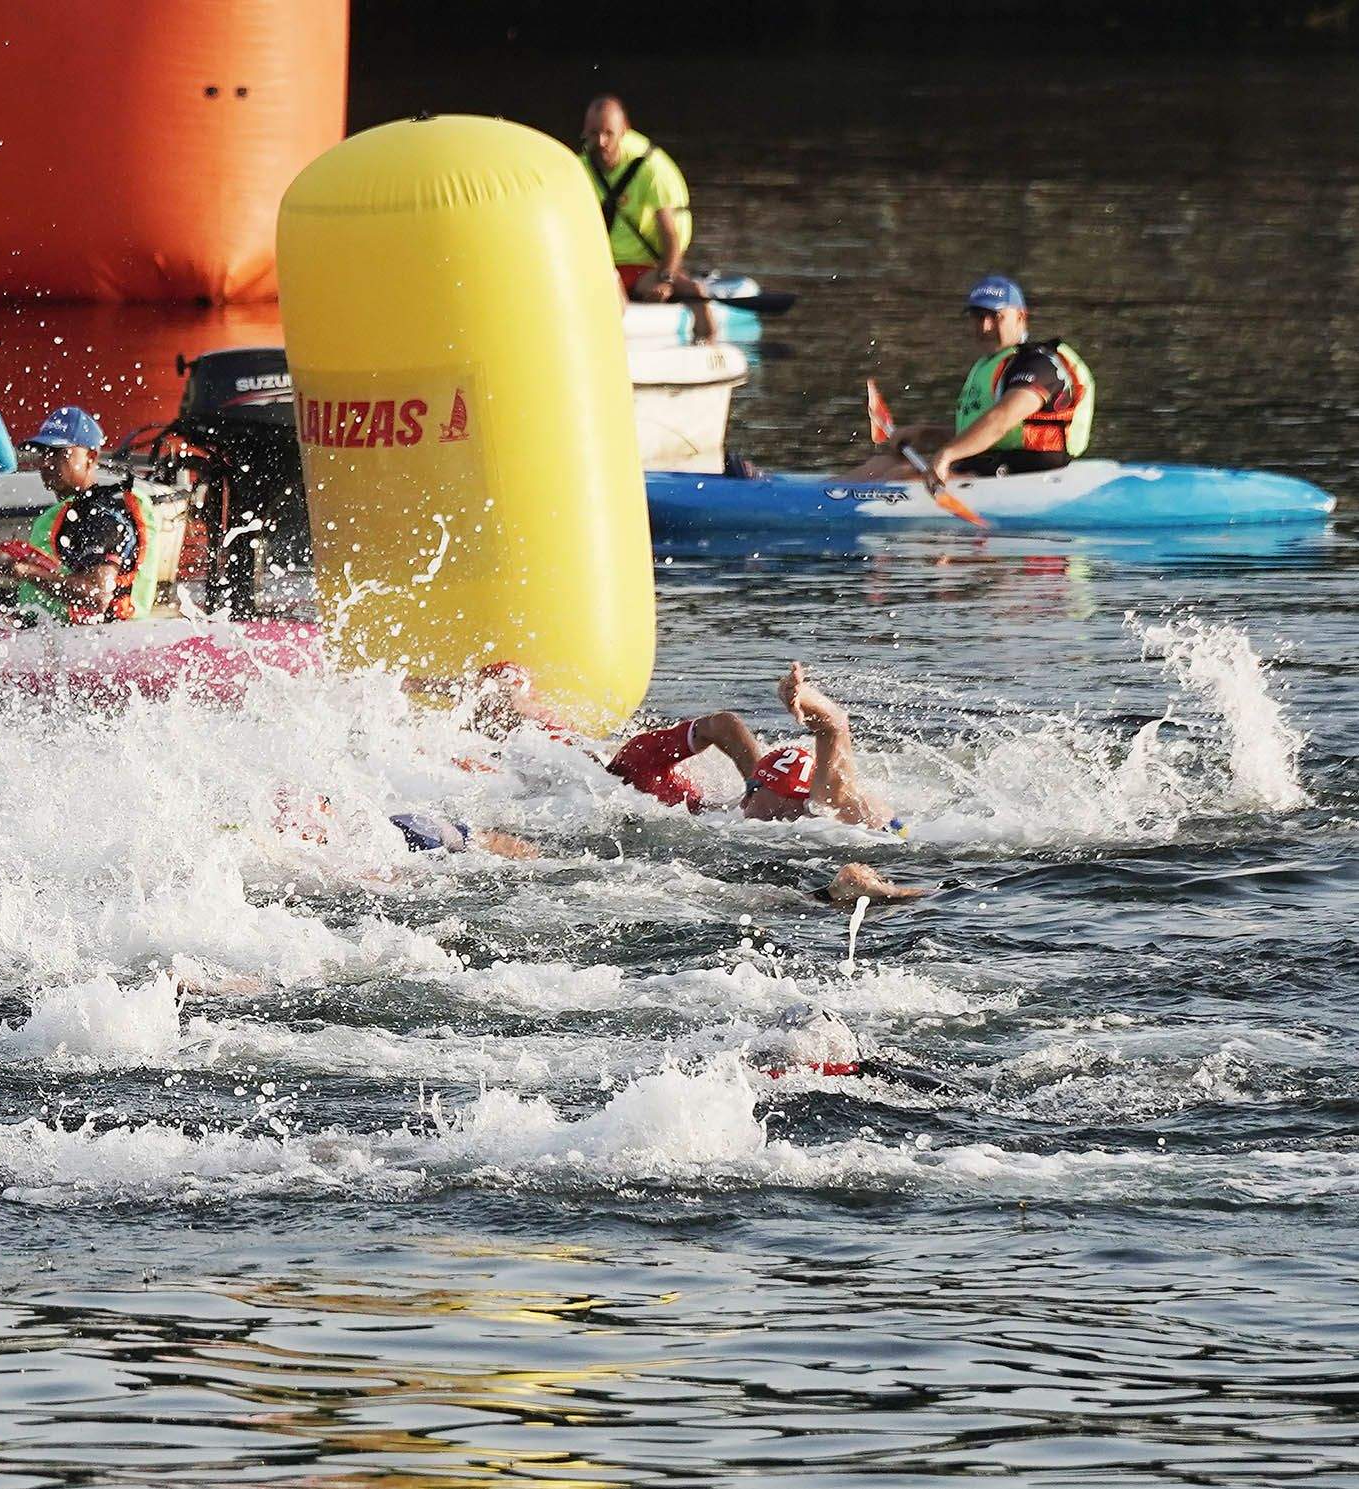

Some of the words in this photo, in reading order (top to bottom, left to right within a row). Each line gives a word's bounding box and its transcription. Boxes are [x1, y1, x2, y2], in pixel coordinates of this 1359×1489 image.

[235, 374, 291, 391] SUZU
[299, 392, 428, 448] LALIZAS
[773, 749, 814, 783] 21
